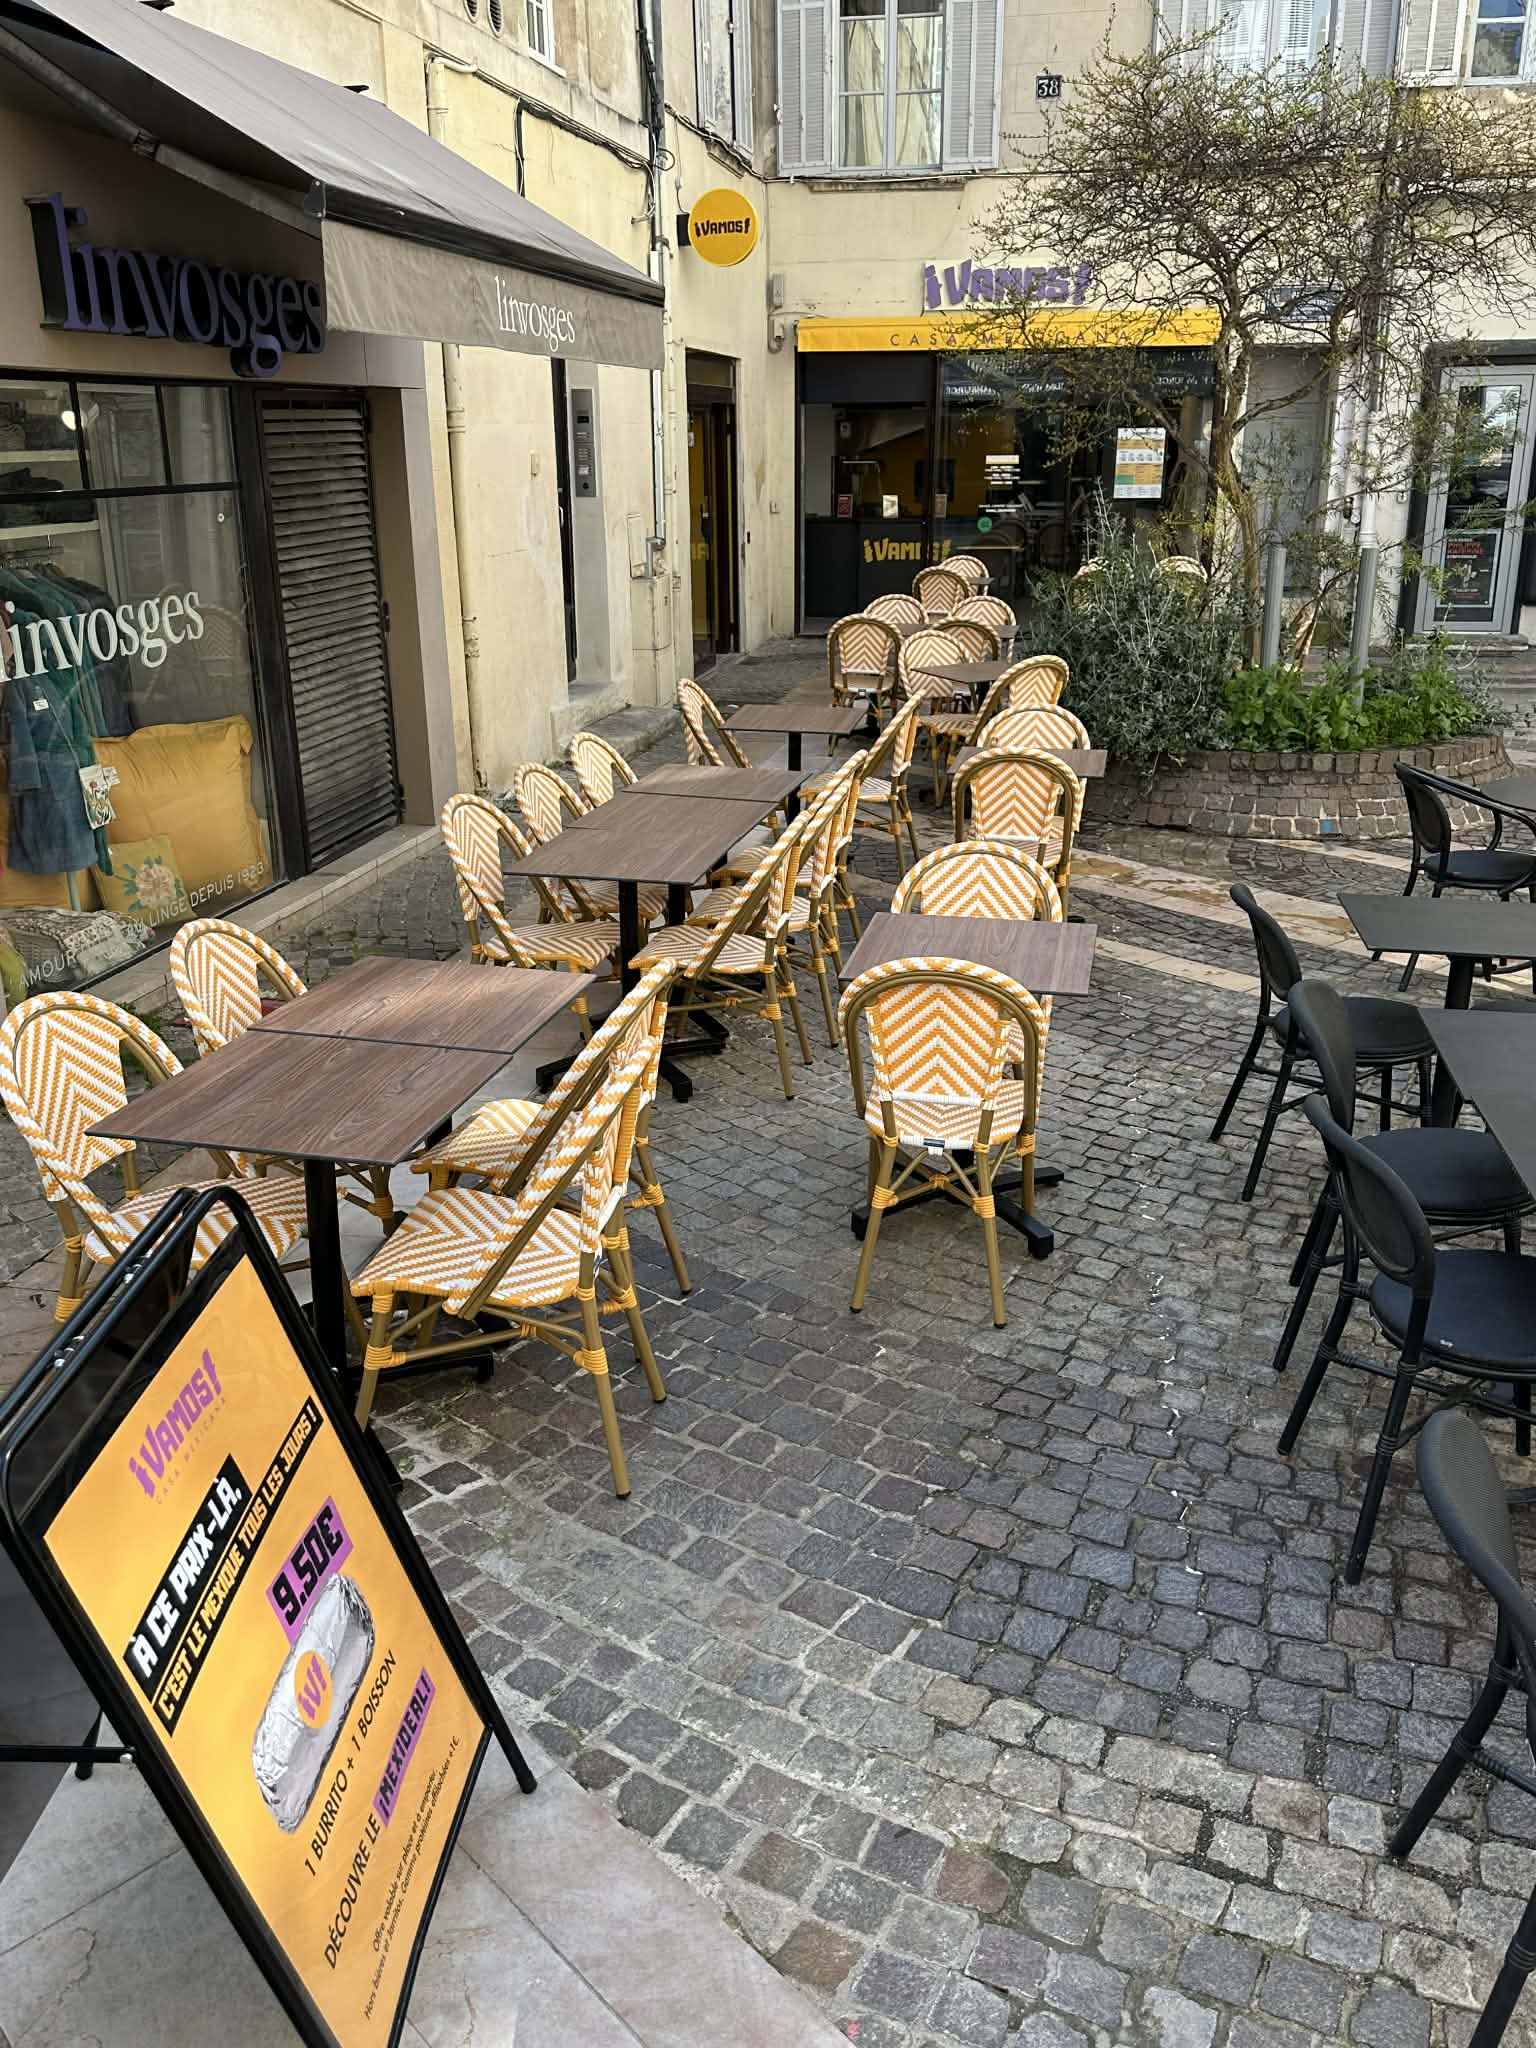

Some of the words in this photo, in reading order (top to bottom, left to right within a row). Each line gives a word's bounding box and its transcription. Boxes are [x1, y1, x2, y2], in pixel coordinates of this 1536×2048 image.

[1038, 79, 1058, 96] 38
[695, 217, 751, 238] ¡VAMOS!
[44, 191, 326, 378] linvosges
[494, 275, 575, 352] linvosges
[890, 333, 957, 346] CASA
[0, 591, 205, 683] invosges
[150, 896, 188, 928] LINGE
[190, 873, 235, 906] DEPUIS
[238, 862, 265, 884] 1923
[128, 1348, 222, 1499] ¡VAMOS!
[158, 1648, 193, 1720] C'EST
[187, 1620, 208, 1659] LE
[200, 1543, 245, 1631] MEXIQUE
[238, 1495, 268, 1550] TOUS
[261, 1467, 284, 1507] LES
[281, 1422, 311, 1475] JOURS
[272, 1504, 344, 1627] 9.50€
[128, 1633, 159, 1678] À
[146, 1588, 181, 1648] CE
[304, 1858, 316, 1877] 1
[311, 1768, 348, 1861] BURRITO
[351, 1735, 361, 1752] 1
[357, 1649, 397, 1739] BOISSON
[324, 1839, 371, 1970] DÉCOUVRE
[365, 1812, 381, 1845] LE
[373, 1920, 386, 1953] Offre
[384, 1880, 399, 1921] valable
[396, 1861, 404, 1882] sur
